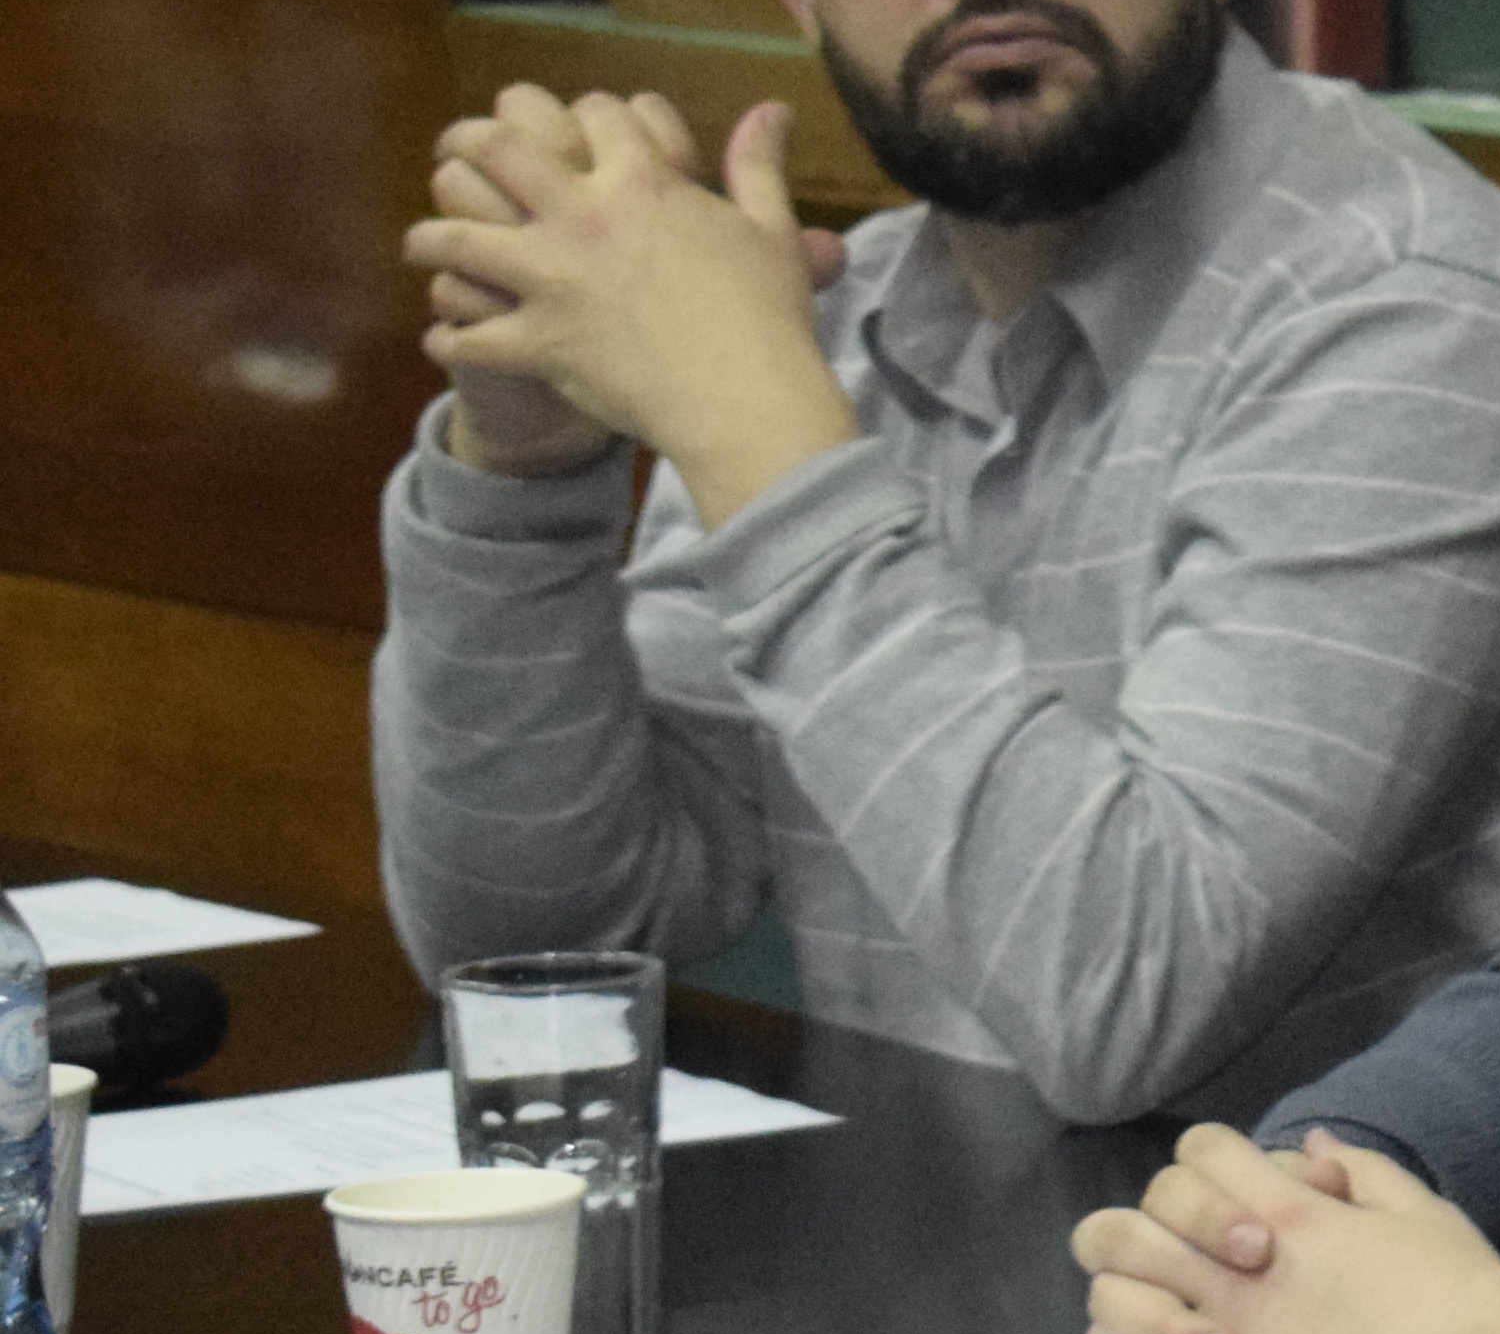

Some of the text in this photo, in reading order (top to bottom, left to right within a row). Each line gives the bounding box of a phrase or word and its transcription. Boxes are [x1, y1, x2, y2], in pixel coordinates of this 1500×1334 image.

[343, 1259, 467, 1288] CAFÉ
[411, 1275, 506, 1334] to go
